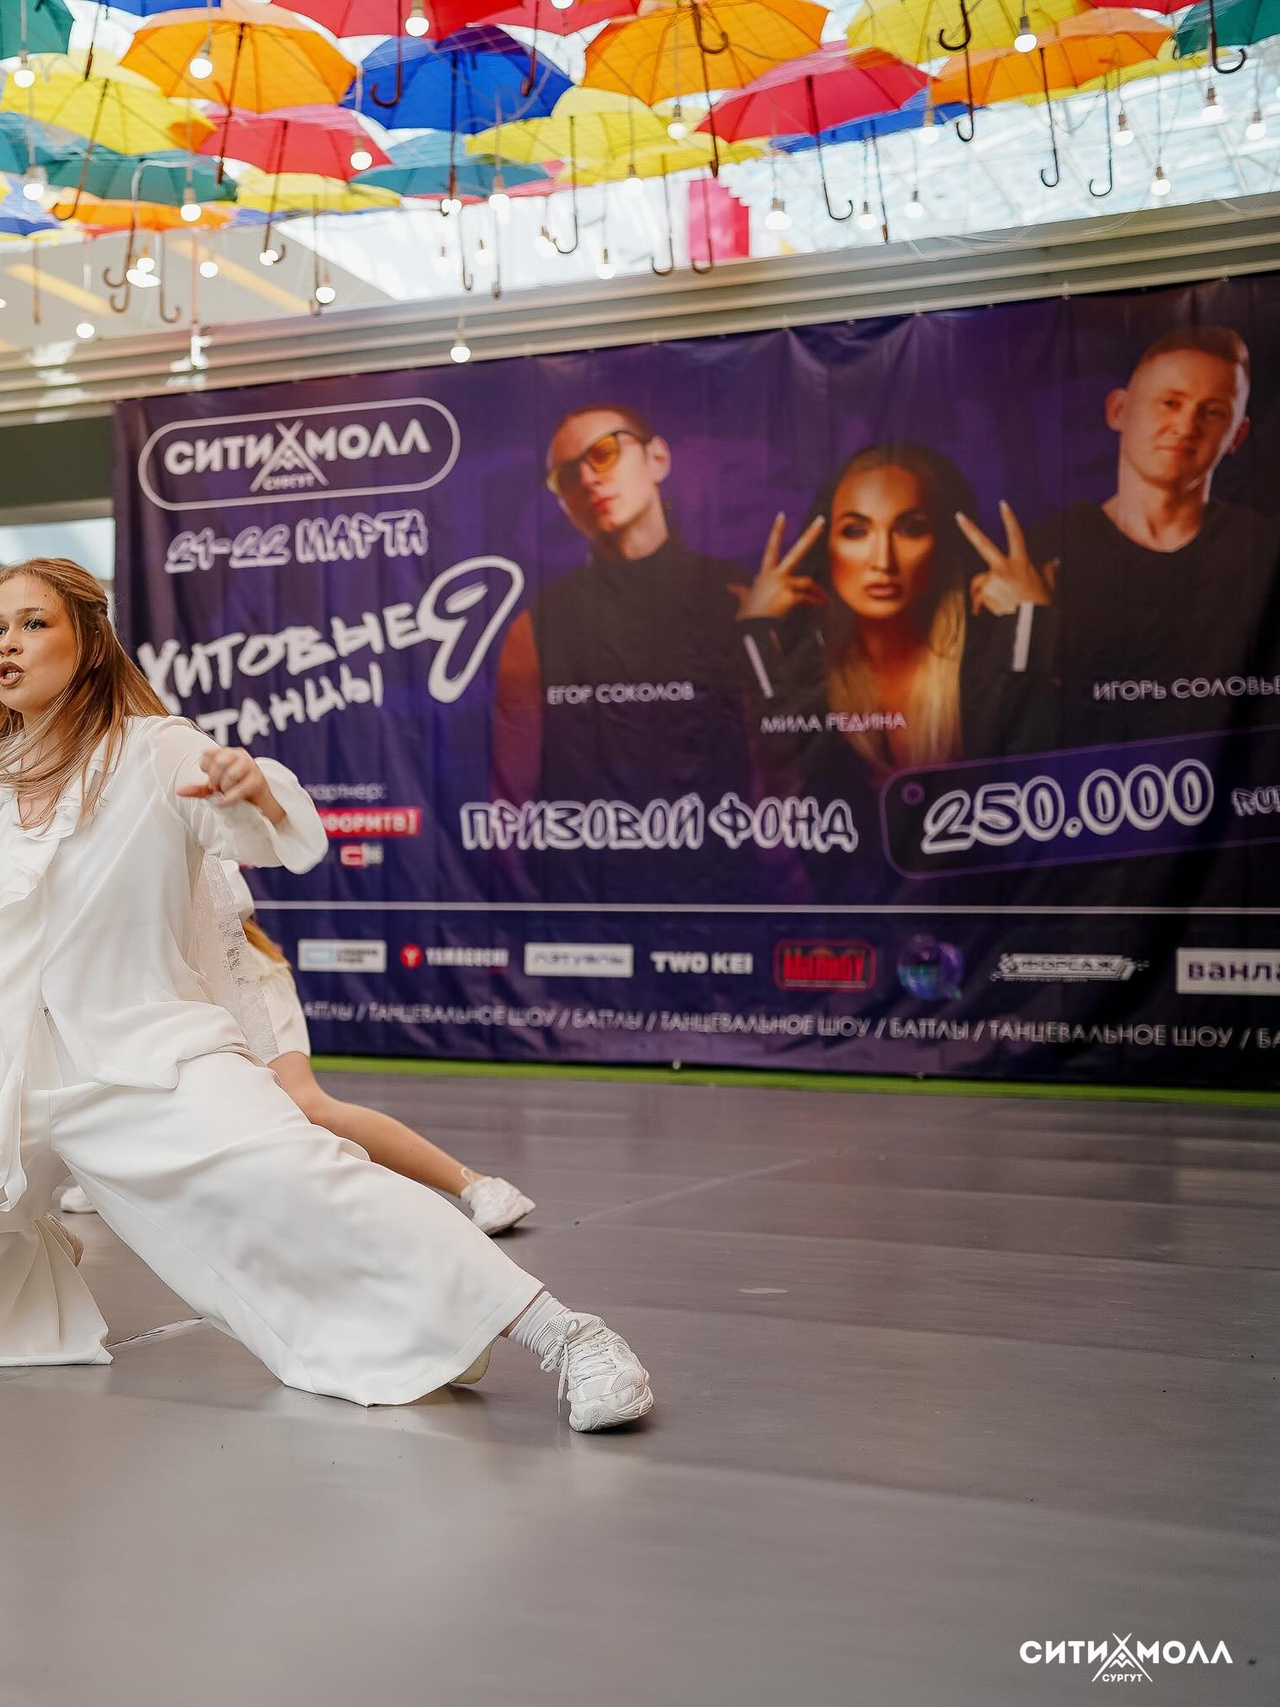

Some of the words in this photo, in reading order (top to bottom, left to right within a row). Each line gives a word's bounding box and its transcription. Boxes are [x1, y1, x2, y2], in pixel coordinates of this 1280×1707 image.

[164, 431, 274, 475] СИТИ
[305, 418, 432, 462] МОЛЛ
[295, 508, 429, 564] МАРТА
[195, 661, 384, 748] ТАНЦЫ
[546, 684, 593, 705] ЕГОР
[595, 681, 695, 703] СОКОЛОВ
[1093, 680, 1167, 701] ИГОРЬ
[760, 713, 822, 734] МИЛА
[825, 711, 908, 733] РЕДИНА
[460, 792, 705, 851] ПРИЗОВОЙ
[920, 758, 1214, 854] 250.000
[650, 950, 709, 974] TWO
[711, 952, 753, 975] KEI
[1187, 961, 1280, 982] ванл
[303, 1001, 354, 1022] АТТЛЫ
[369, 1001, 507, 1027] ТАНЦЕВАЛЬНОЕ
[507, 1004, 557, 1028] ШОУ
[572, 1007, 644, 1031] БАТТЛЫ
[659, 1010, 814, 1036] ТАНЦЕВАЛЬНОЕ
[817, 1014, 870, 1038] ШОУ
[889, 1017, 969, 1040] БАТТЛЫ
[989, 1019, 1167, 1046] ТАНЦЕВАЛЬНОЕ
[1173, 1025, 1233, 1049] ШОУ
